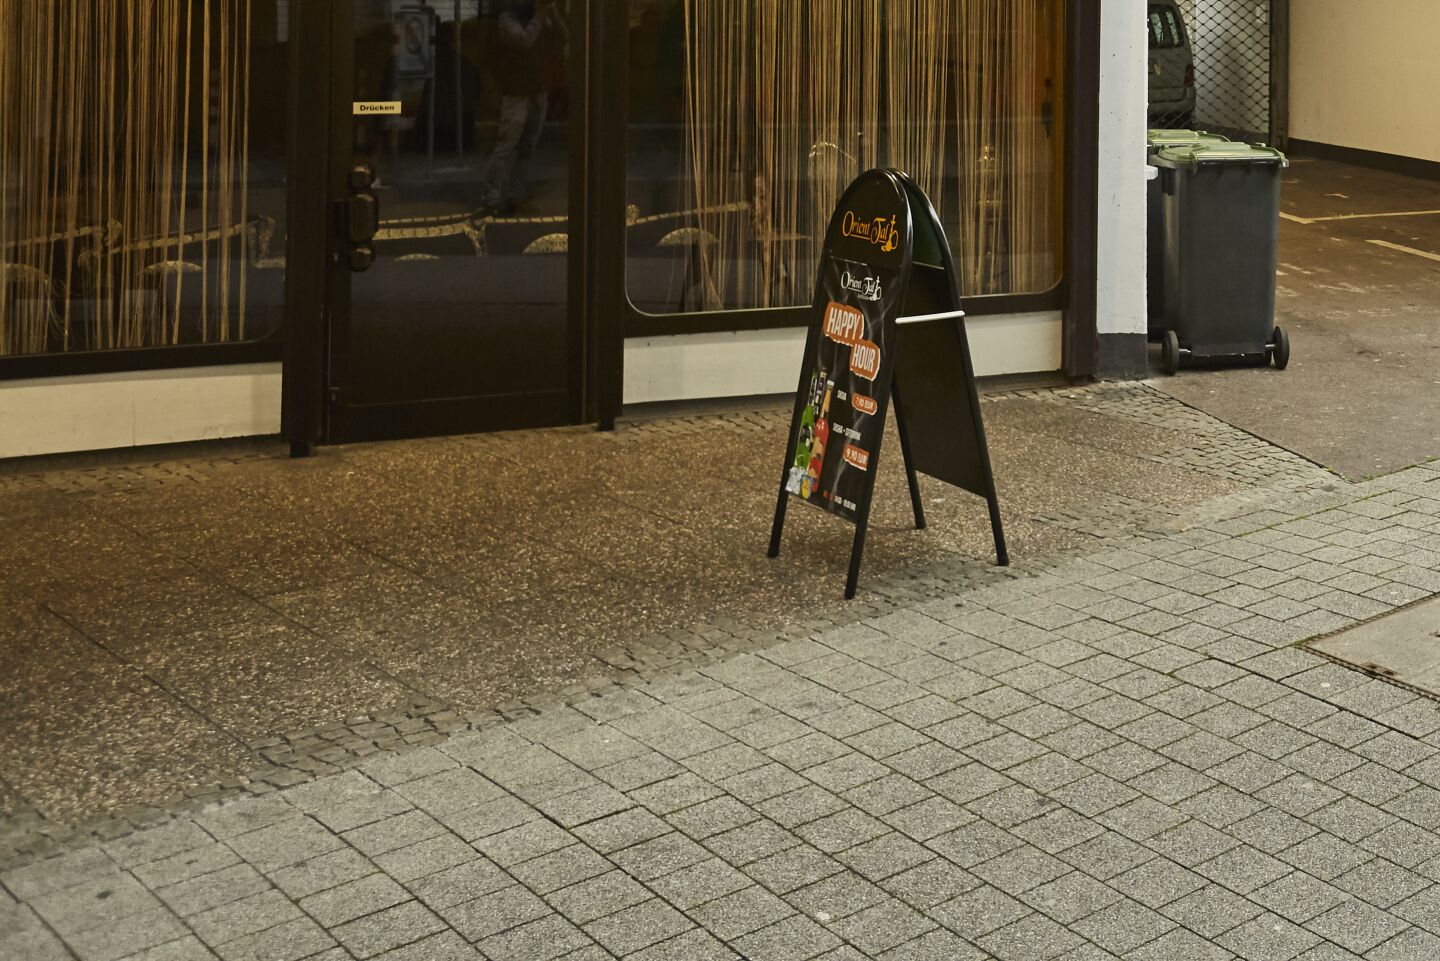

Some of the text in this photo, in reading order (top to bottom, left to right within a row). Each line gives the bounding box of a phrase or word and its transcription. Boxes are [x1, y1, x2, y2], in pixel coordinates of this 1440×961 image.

[842, 210, 870, 240] Orient
[826, 307, 862, 340] HAPPY
[851, 343, 876, 373] HOUR
